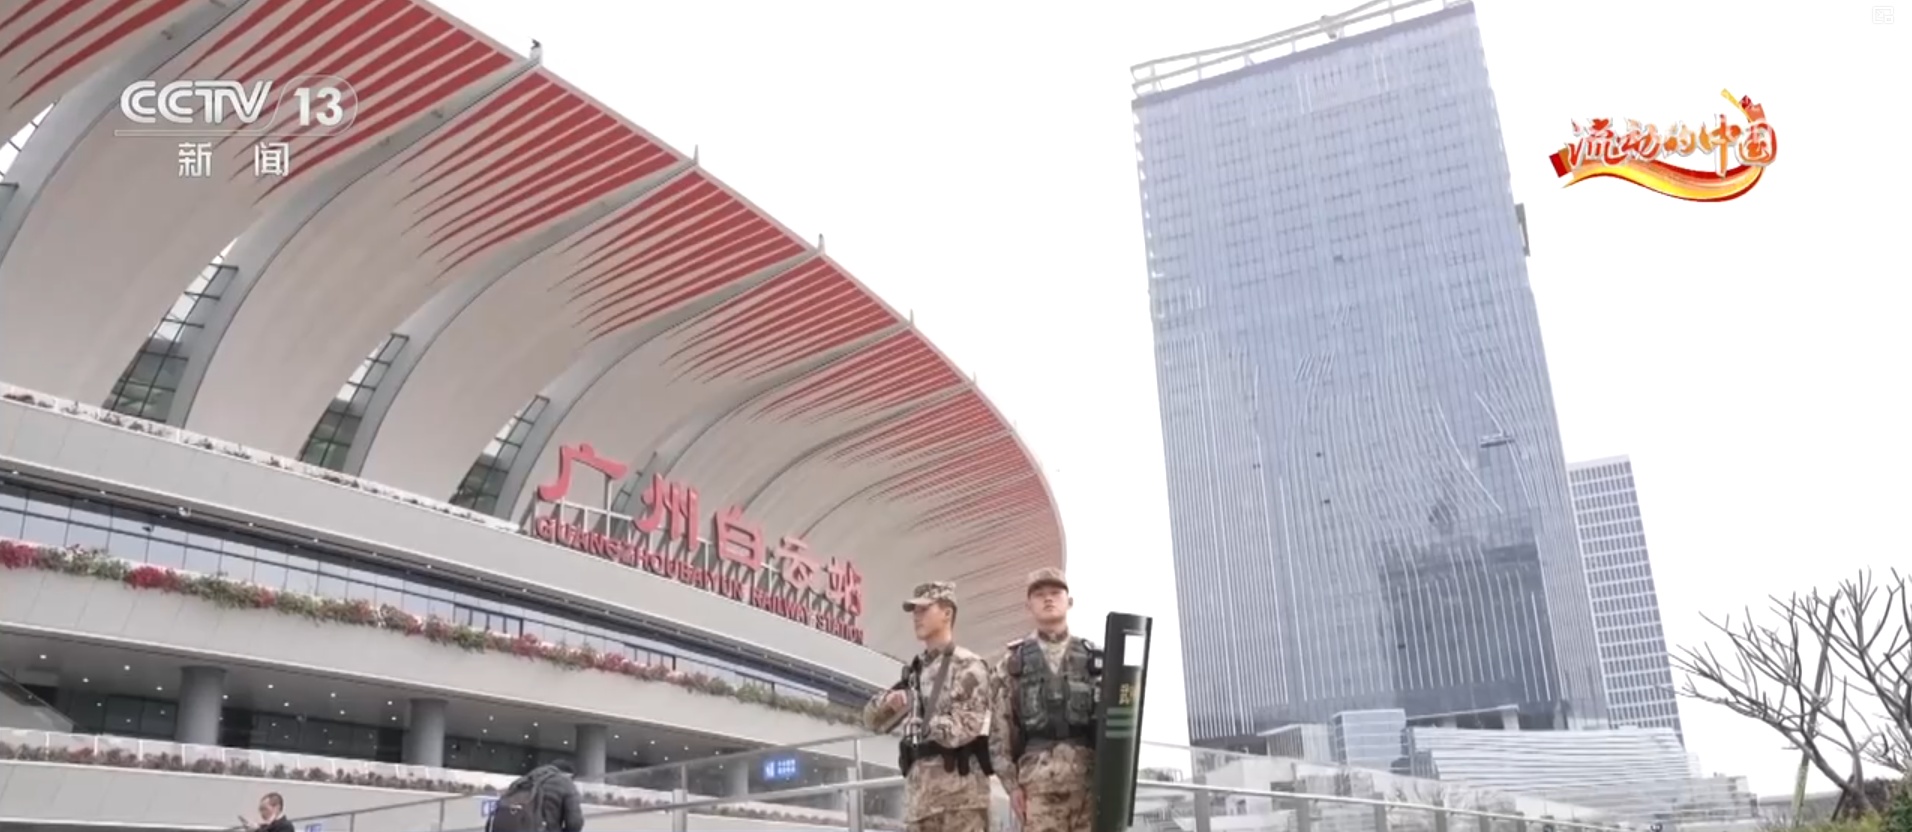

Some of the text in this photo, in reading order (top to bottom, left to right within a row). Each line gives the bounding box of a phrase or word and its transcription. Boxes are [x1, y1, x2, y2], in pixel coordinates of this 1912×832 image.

[537, 443, 864, 617] 广州白云站
[751, 587, 809, 626] RAILWAY
[816, 614, 864, 645] STATION
